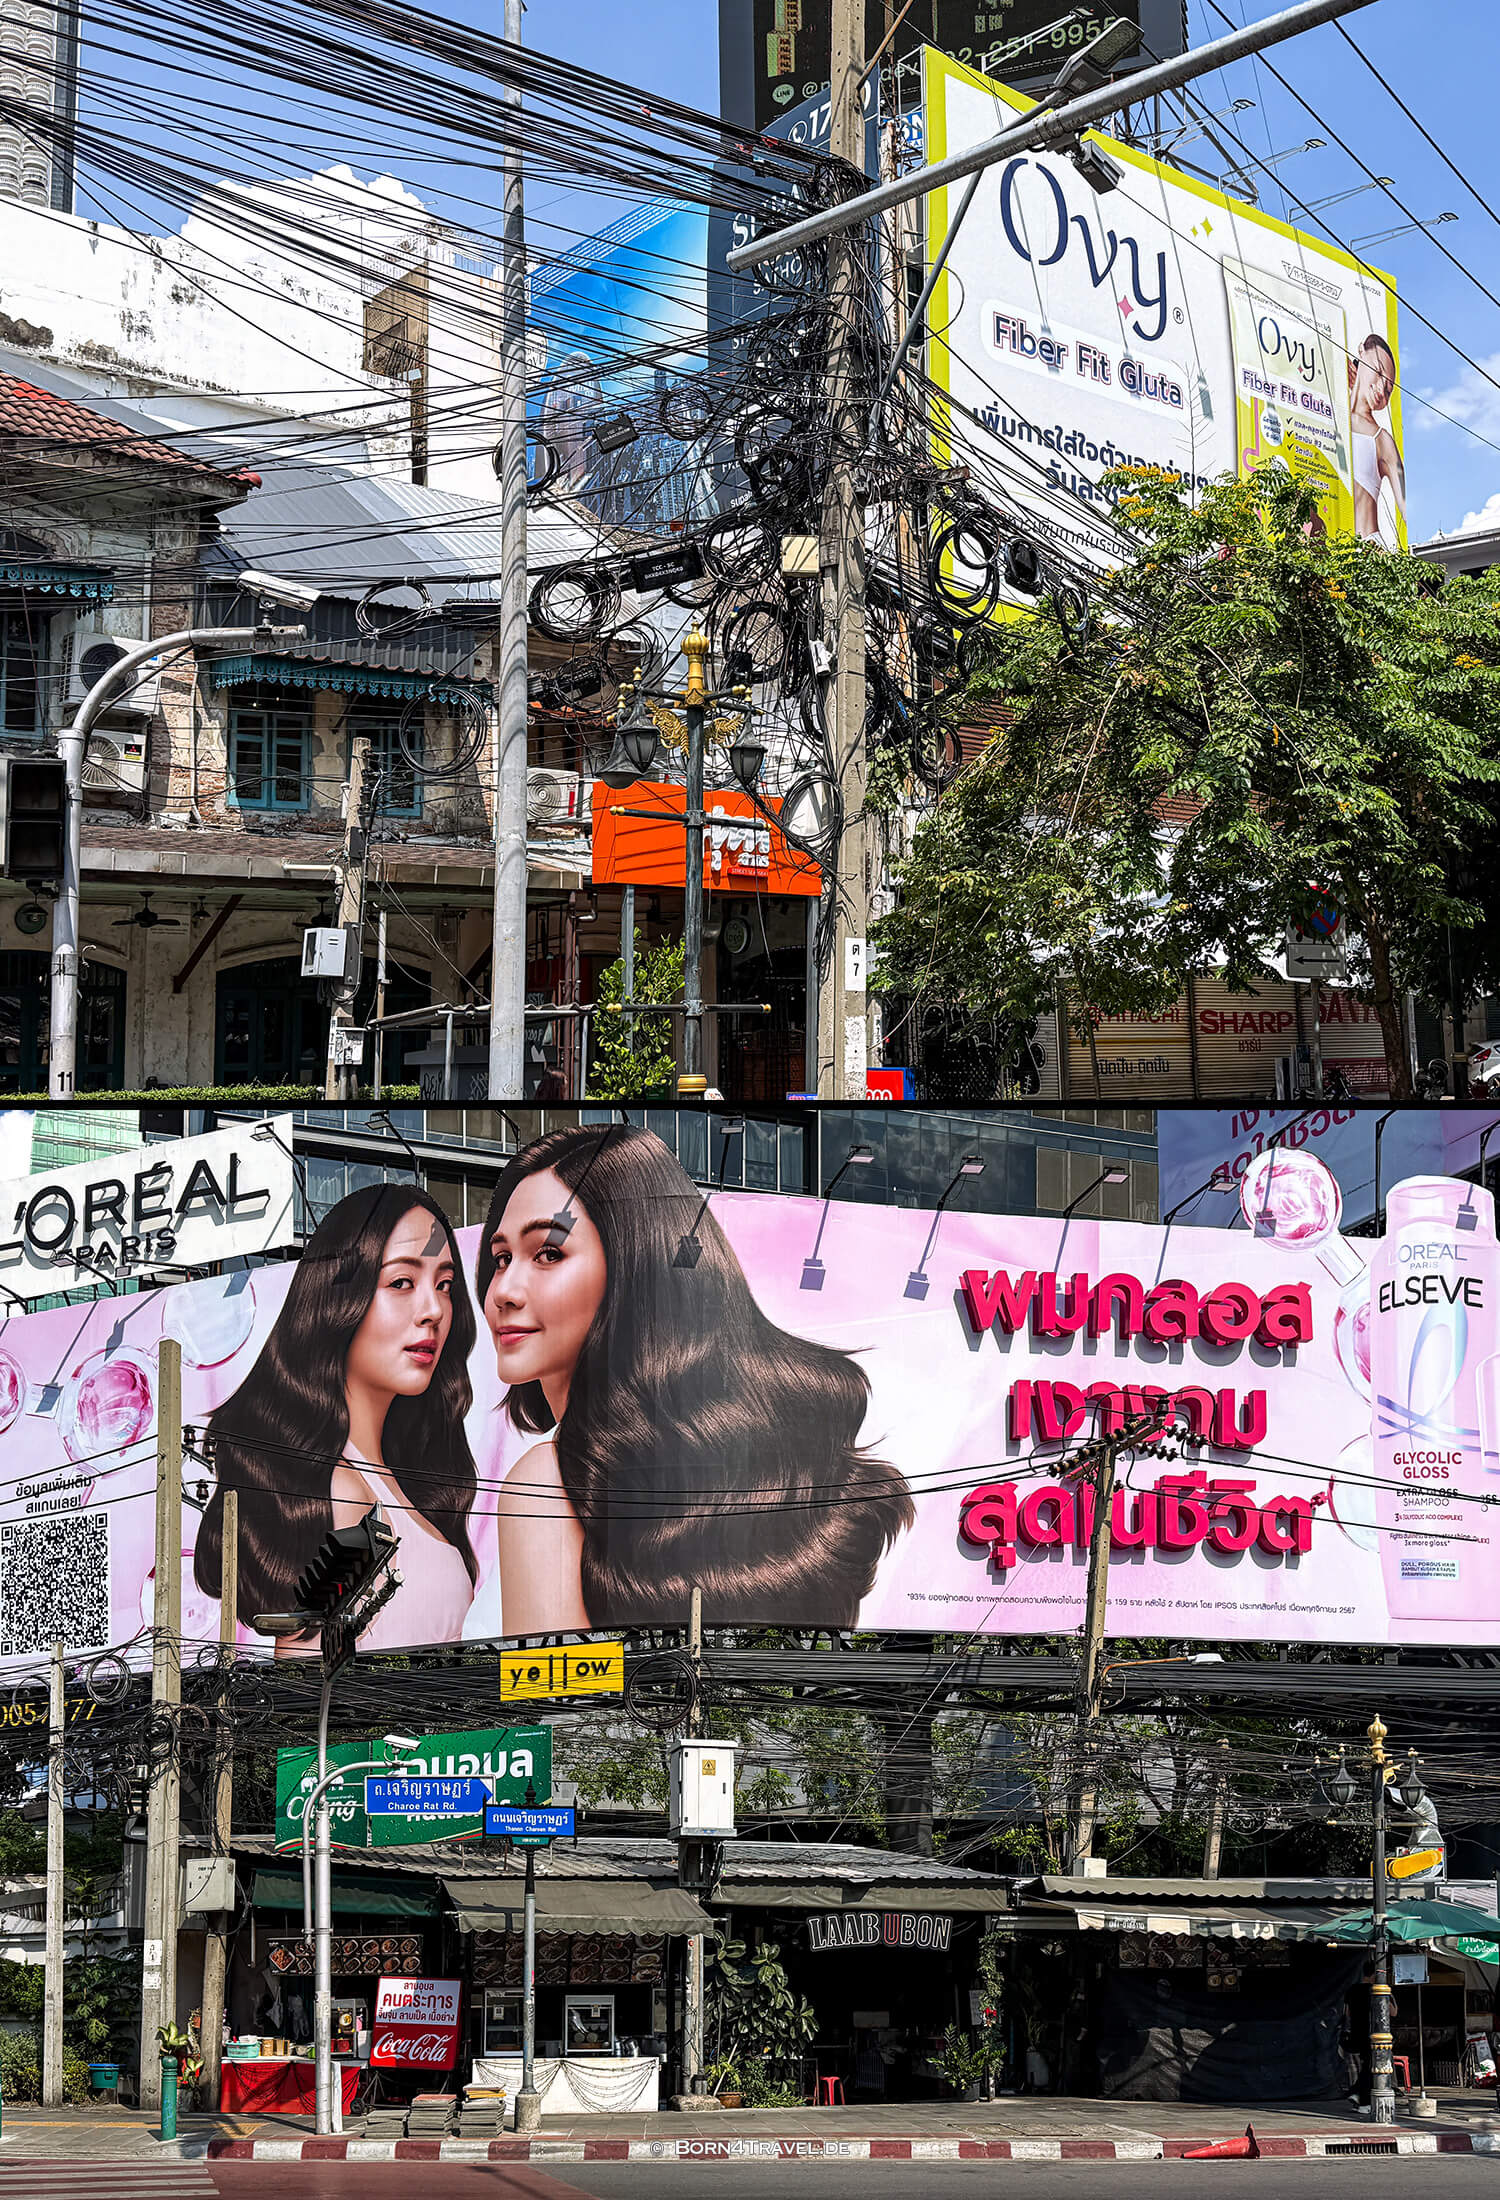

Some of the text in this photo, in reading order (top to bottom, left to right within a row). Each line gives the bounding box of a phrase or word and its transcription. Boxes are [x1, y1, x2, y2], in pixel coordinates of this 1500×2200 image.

[950, 17, 1117, 67] 2-251-995
[1000, 158, 1167, 342] Ovy
[993, 312, 1183, 409] Fiber Fit Gluta
[1259, 317, 1315, 382] Ovy
[1242, 368, 1333, 417] Fiber Fit Gluta
[1200, 1009, 1294, 1034] SHARP
[57, 1071, 72, 1092] 11
[75, 1227, 177, 1266] PARIS
[1409, 1261, 1439, 1270] PARIS
[1379, 1275, 1484, 1313] ELSEVE
[1393, 1452, 1462, 1465] GLYCOLIC
[1403, 1466, 1450, 1479] GLOSS
[25, 1494, 82, 1513] สแกนเลย!
[1403, 1498, 1450, 1507] SHAMPOO
[1215, 1602, 1237, 1610] IPSOS
[510, 1653, 611, 1690] yellow
[287, 1796, 357, 1822] Chng
[388, 1802, 457, 1810] Charoe Rat Rd.
[808, 1913, 952, 1949] LAAB UBON
[404, 1982, 434, 1993] ลาบอุบล
[383, 1993, 453, 2009] คนตระการ
[374, 2032, 454, 2062] Coca-Cola
